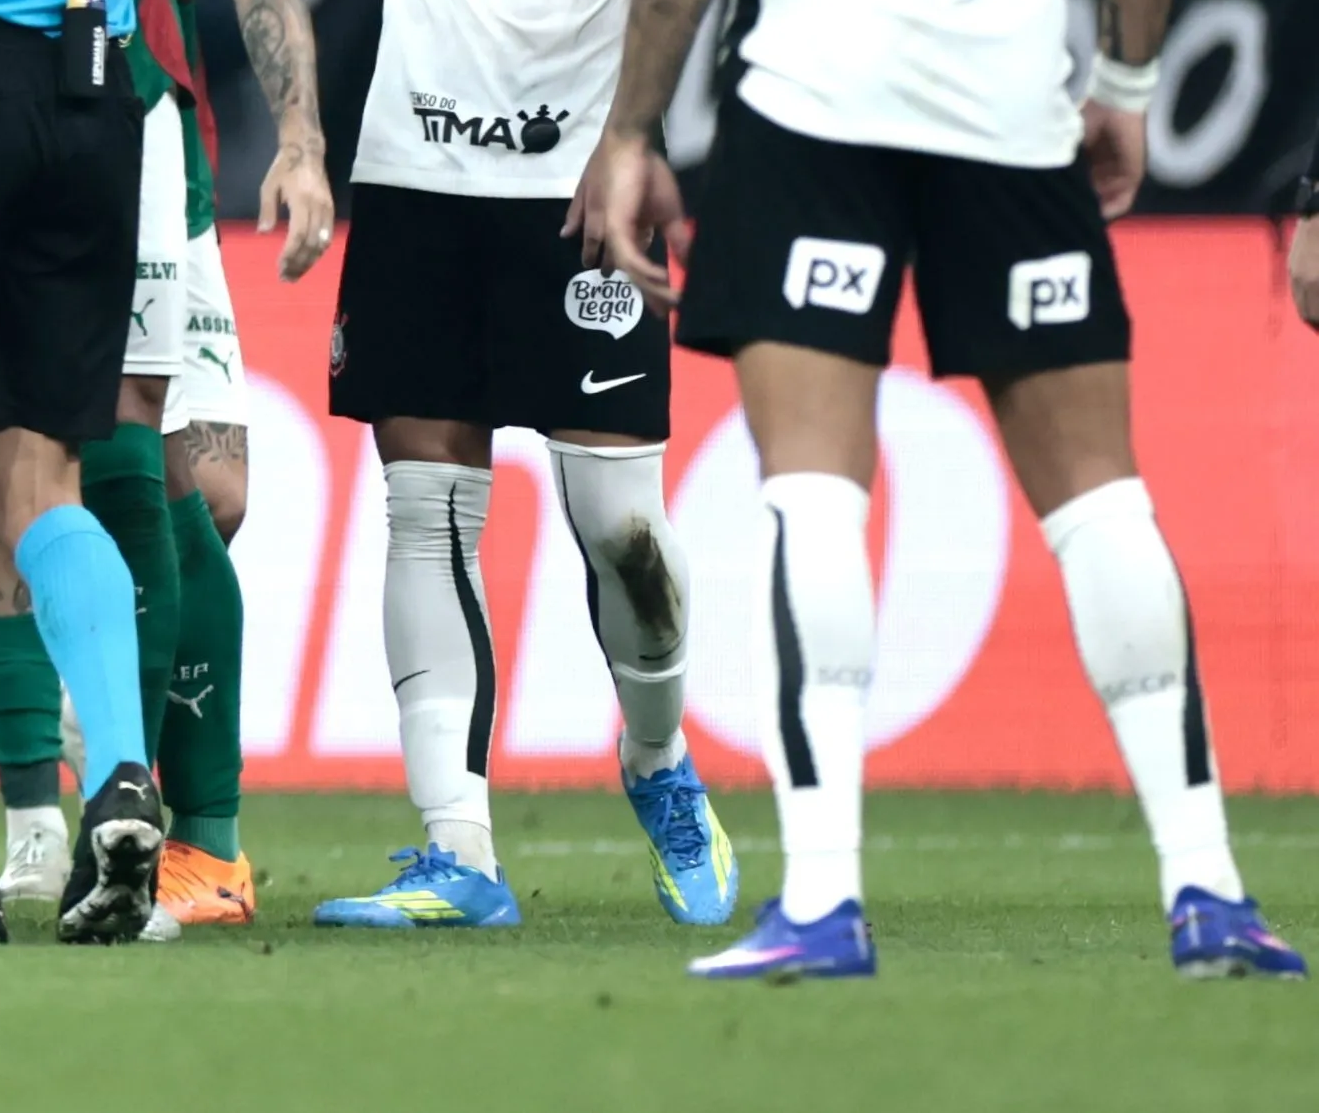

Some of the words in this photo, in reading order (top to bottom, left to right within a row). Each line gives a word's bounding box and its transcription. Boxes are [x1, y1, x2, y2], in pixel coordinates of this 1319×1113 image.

[572, 278, 634, 303] Broto
[804, 257, 868, 304] px
[578, 296, 635, 324] Legal
[1029, 275, 1080, 323] px
[173, 661, 210, 681] EP
